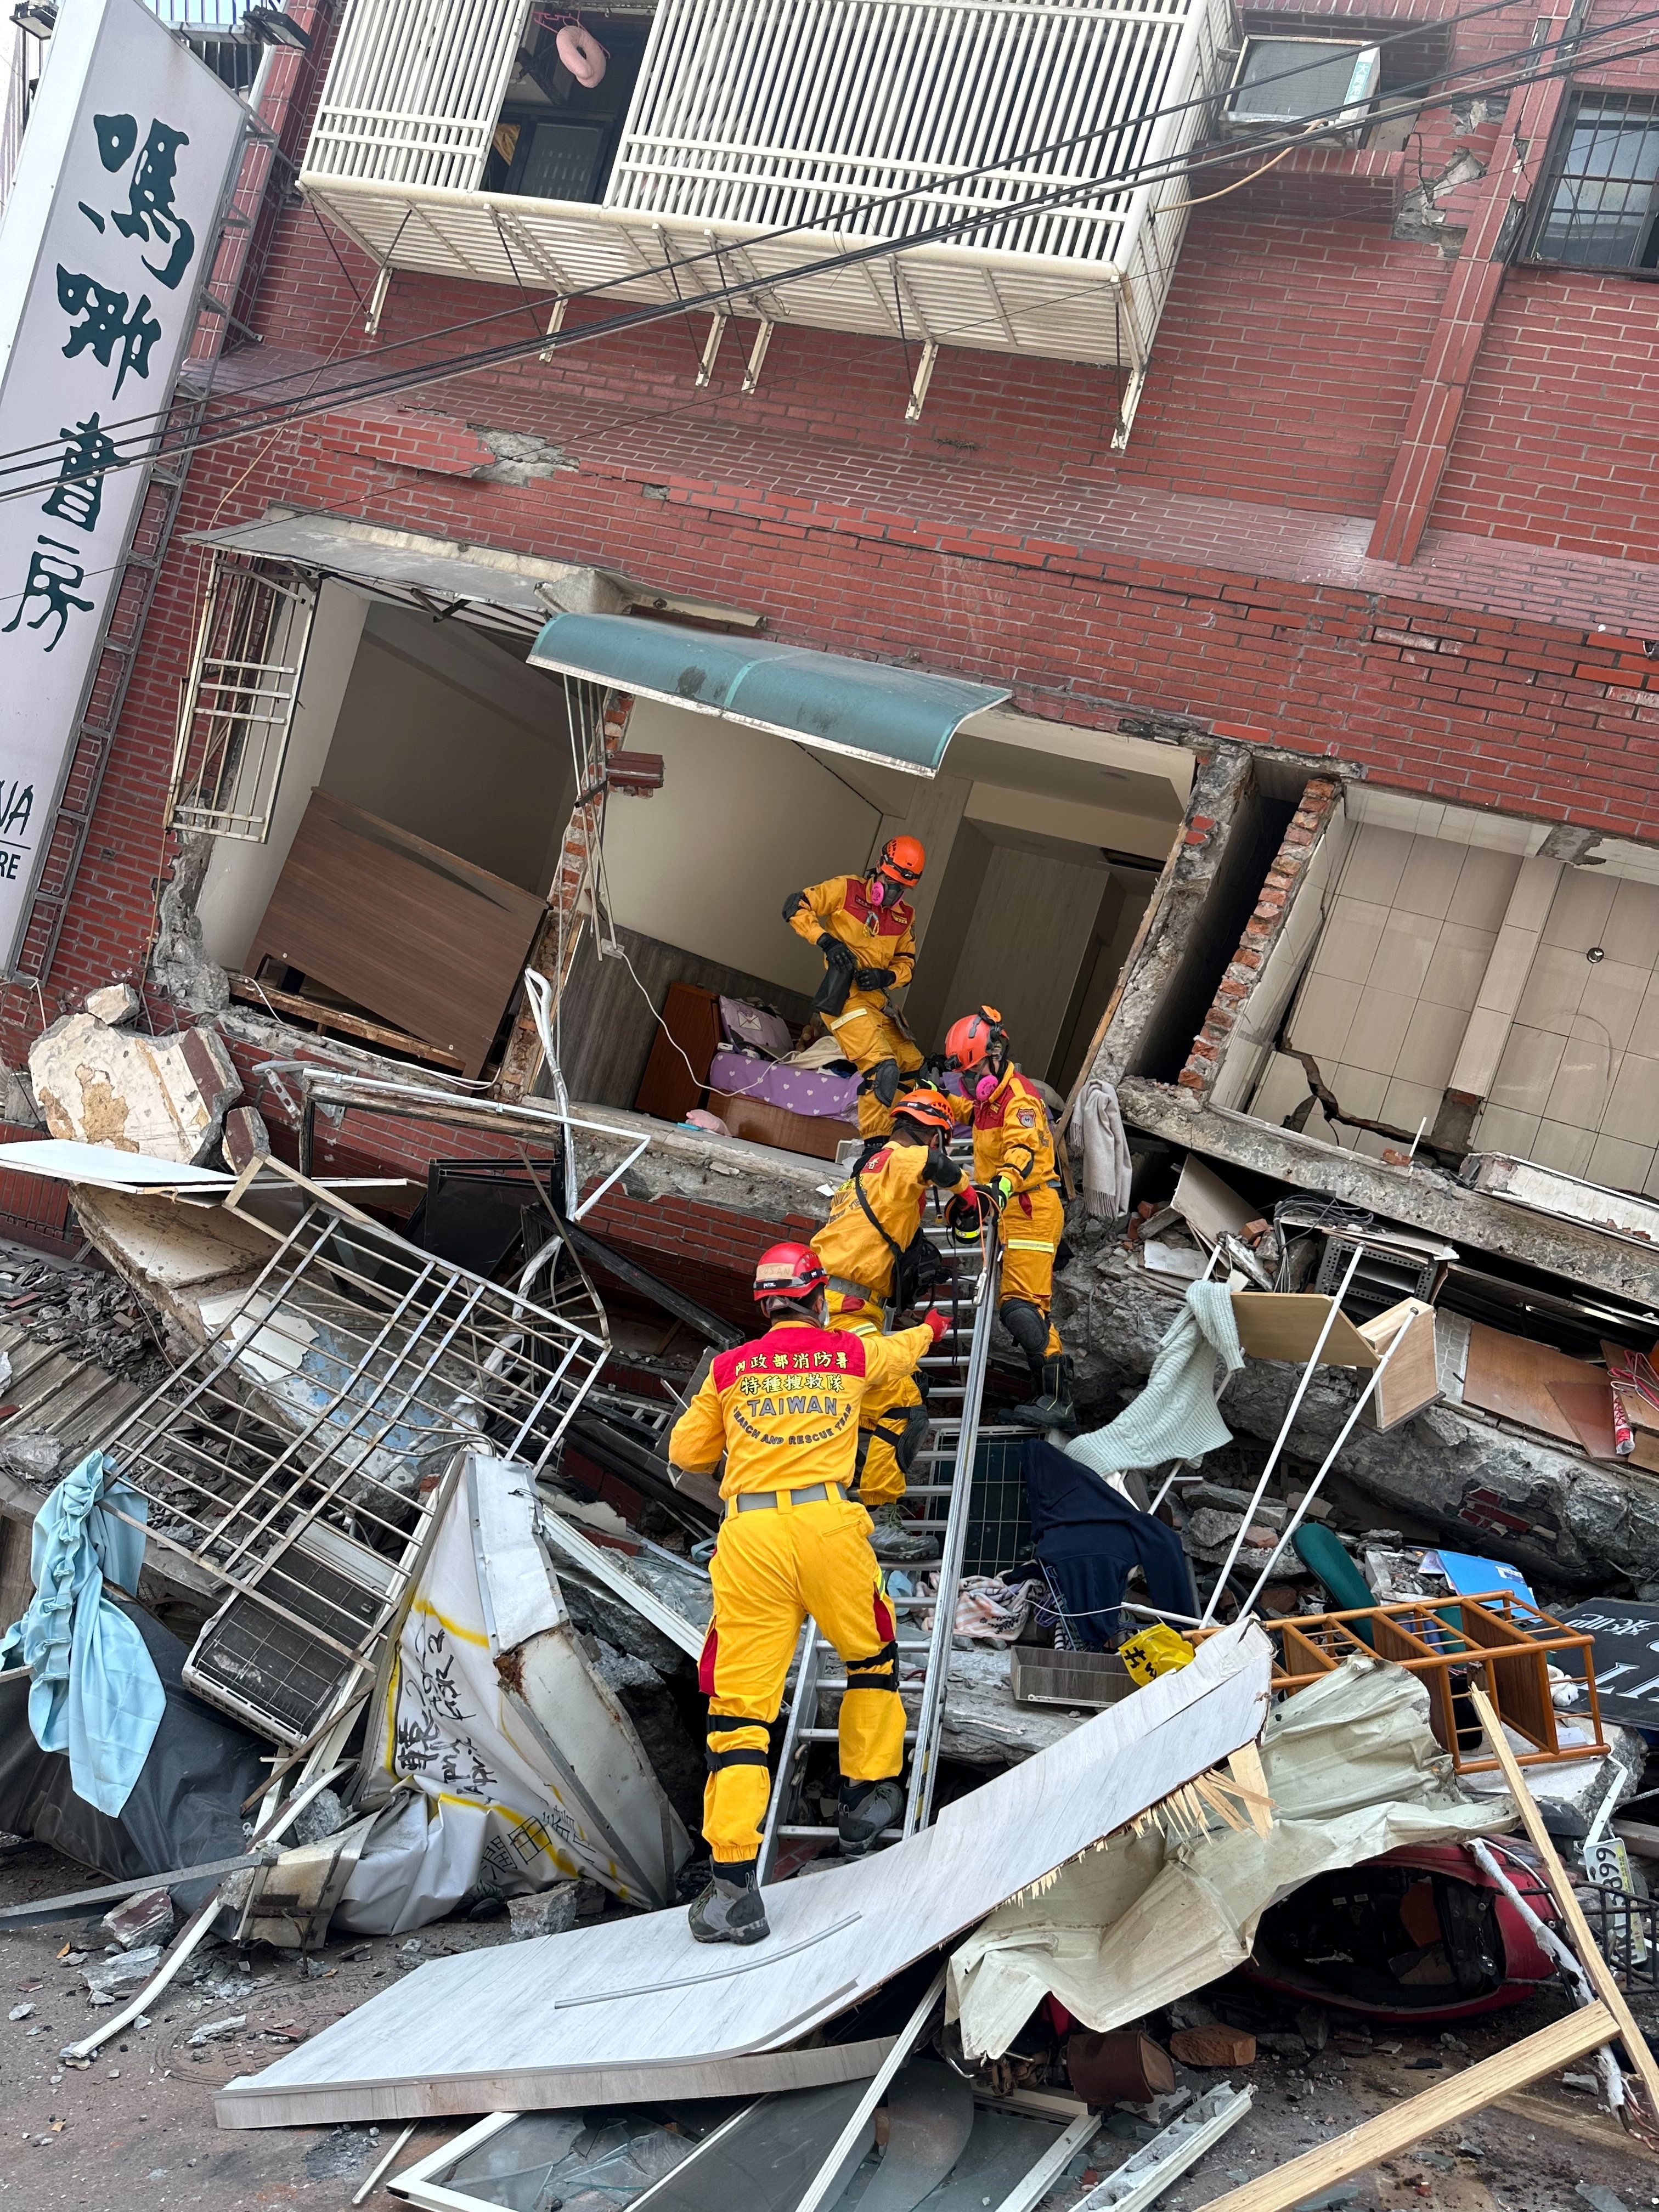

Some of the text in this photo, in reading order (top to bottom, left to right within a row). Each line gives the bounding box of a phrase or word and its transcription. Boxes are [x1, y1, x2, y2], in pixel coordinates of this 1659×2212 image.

[741, 1373, 845, 1395] 特種搜救隊
[747, 1395, 837, 1417] TAIWAN
[761, 1434, 784, 1444] AND
[788, 1428, 834, 1445] RESCUE
[835, 1403, 851, 1431] TEAM
